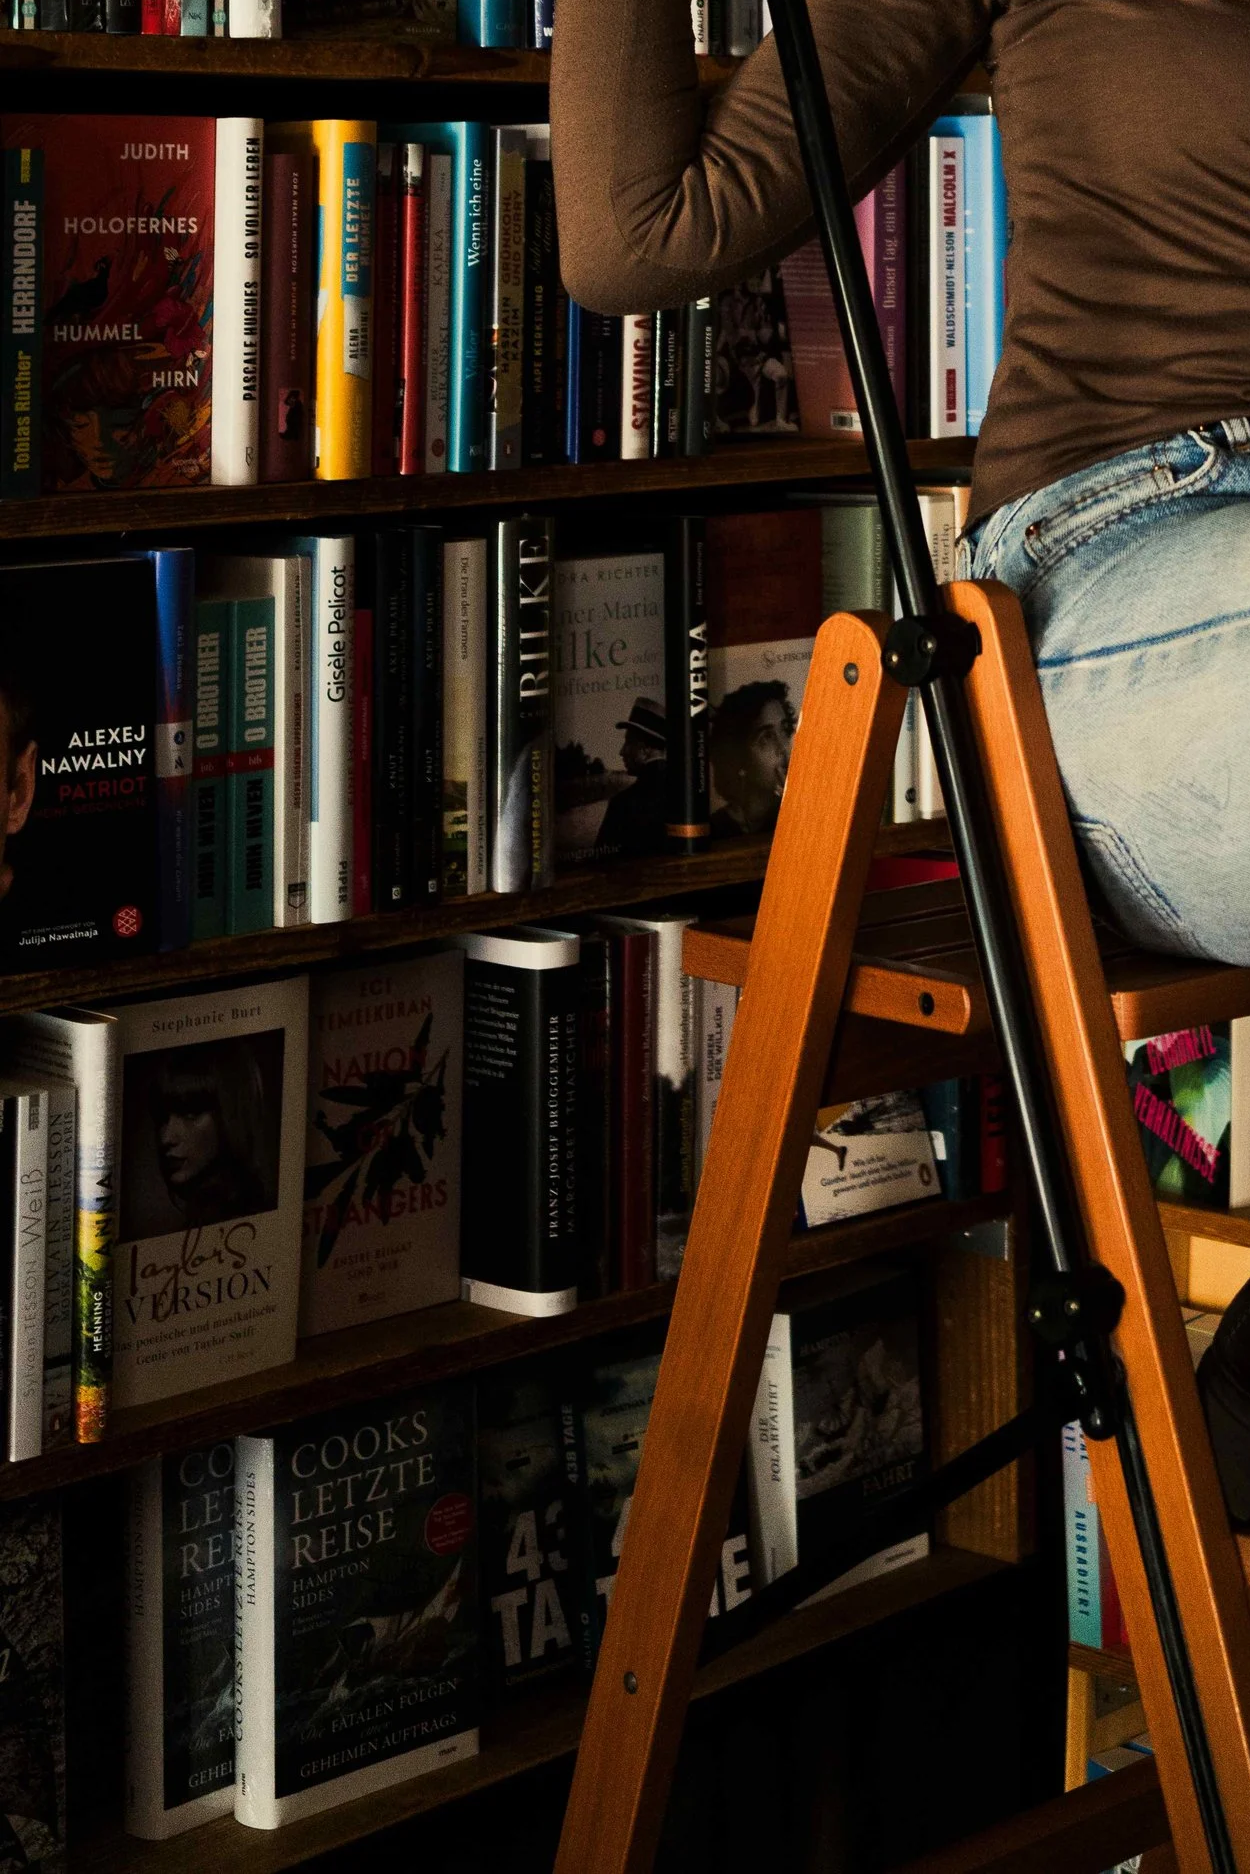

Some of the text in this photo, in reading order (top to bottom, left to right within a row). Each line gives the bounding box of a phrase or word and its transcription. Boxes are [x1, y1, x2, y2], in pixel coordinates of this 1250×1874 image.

[696, 8, 704, 43] KNAUR
[120, 143, 188, 160] JUDITH
[467, 158, 482, 267] Wenn ich eine
[943, 150, 956, 226] MALCOLM X
[64, 217, 197, 234] HOLOFERNES
[12, 199, 36, 335] HERRNDORF
[243, 138, 260, 400] PASCALE HUGUES SO VOLLER LEBEN
[54, 324, 143, 342] HUMMEL
[152, 370, 198, 388] HIRN
[327, 565, 346, 703] Gisèle Pelicot
[519, 536, 549, 700] RILKE
[603, 599, 659, 622] Maria
[245, 626, 266, 722] BROTHER
[689, 622, 708, 718] VERA
[42, 749, 146, 775] NAWALNY
[68, 725, 145, 749] ALEXEJ
[59, 776, 145, 802] PATRIOT
[19, 928, 98, 945] Julija Nawalnaja
[322, 1046, 427, 1088] NATION
[549, 1015, 560, 1238] FRANZ-JOSEF BRÜGGEMEIER
[92, 1291, 103, 1353] HENNING
[126, 1265, 272, 1325] VERSION
[292, 1410, 428, 1478] COOKS
[770, 1381, 781, 1482] POLARFAHRT
[292, 1454, 436, 1526] LETZTE
[292, 1508, 398, 1570] REISE
[1075, 1511, 1090, 1616] AUSRADIERT
[292, 1558, 370, 1594] HAMPTON
[293, 1586, 334, 1610] SIDES
[332, 1679, 458, 1733] FATALEN FOLGEN
[300, 1712, 456, 1779] GEHEIMEN AUFTRAGS
